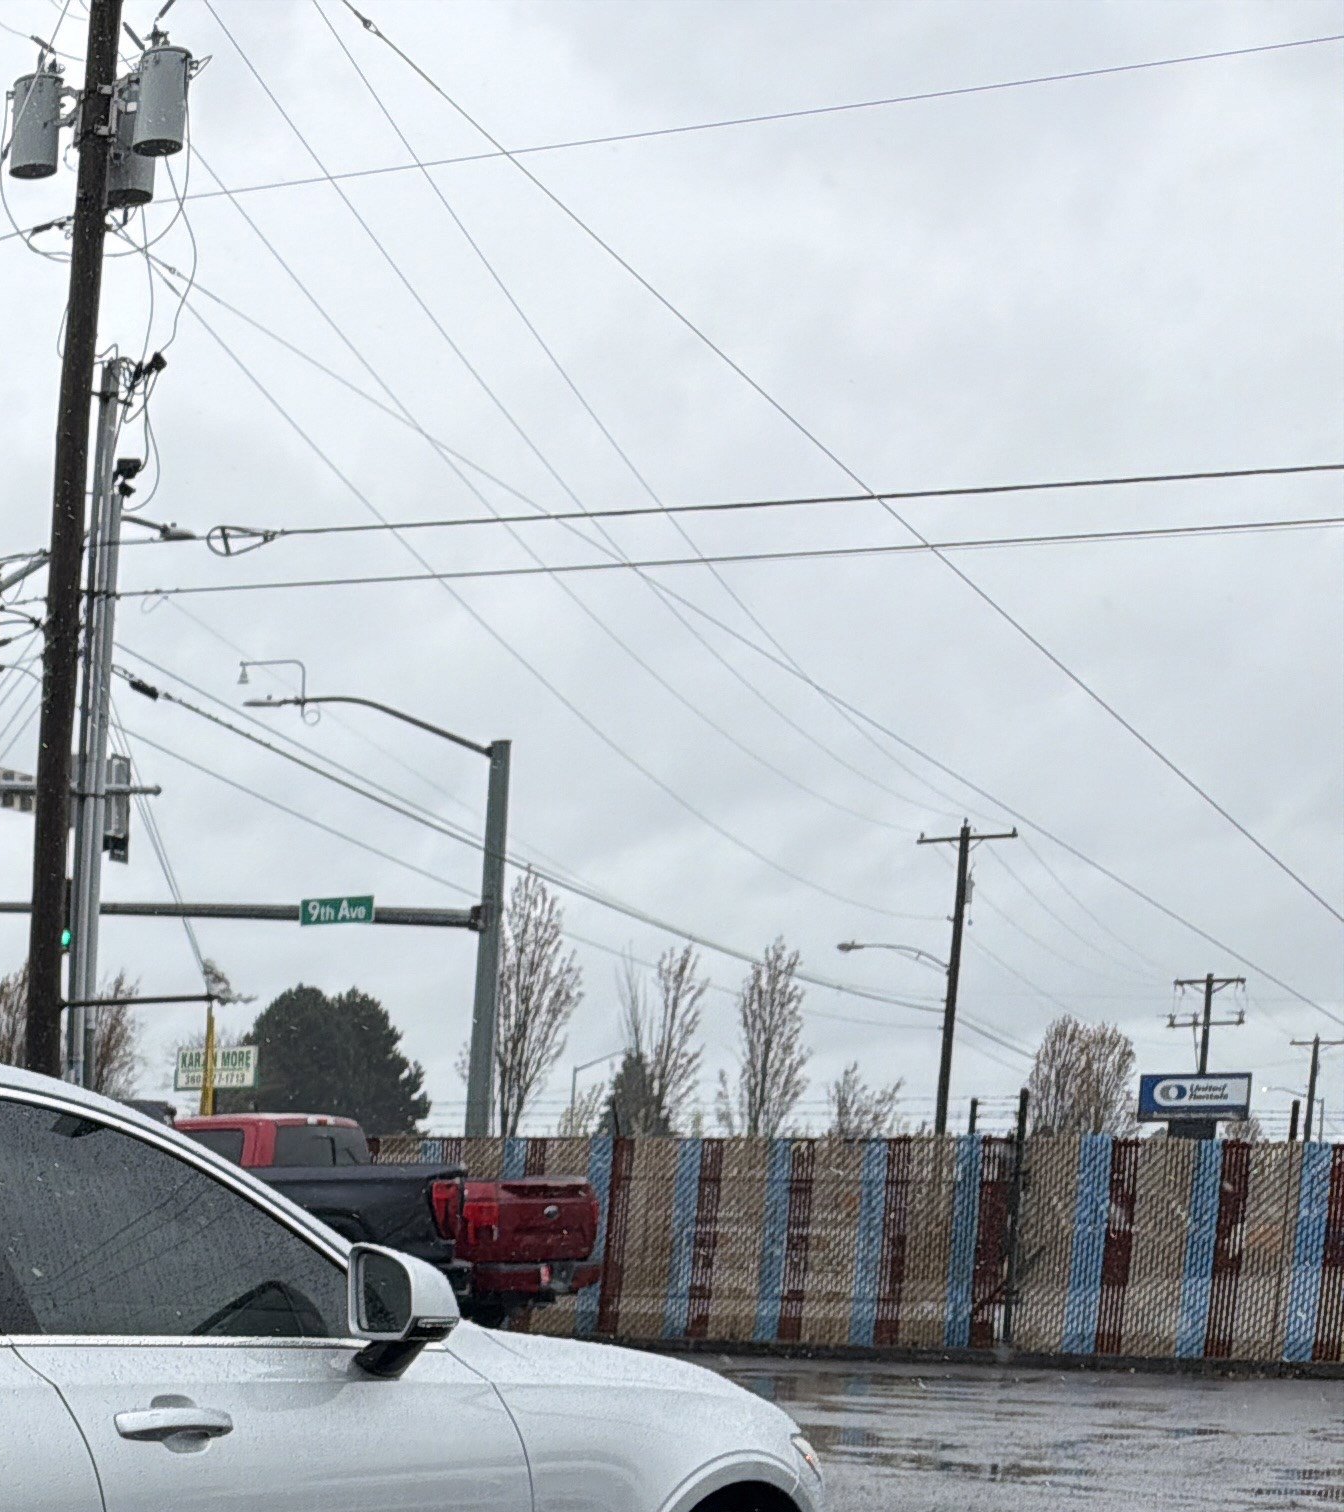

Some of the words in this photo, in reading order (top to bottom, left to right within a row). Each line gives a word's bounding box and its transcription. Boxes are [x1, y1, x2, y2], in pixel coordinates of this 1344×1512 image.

[308, 901, 334, 921] 9th
[337, 900, 366, 920] Ave
[221, 1049, 252, 1068] MORE
[1189, 1083, 1227, 1094] United
